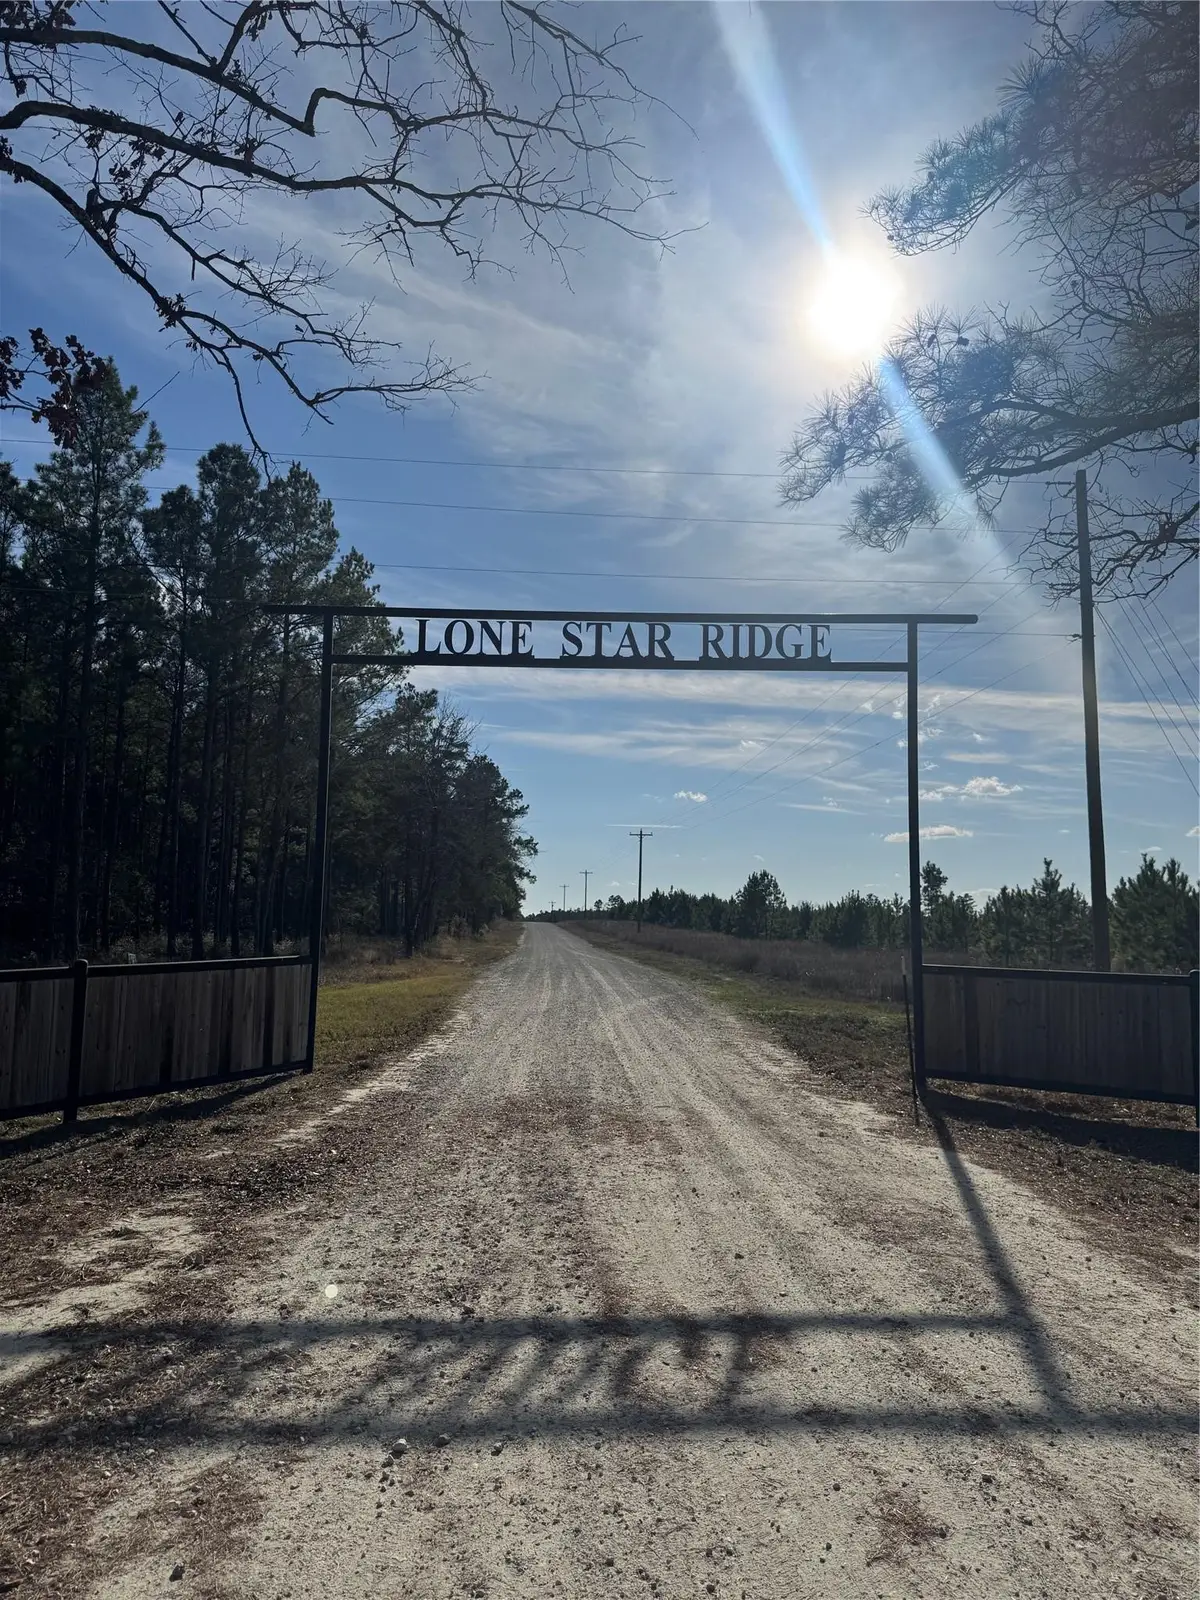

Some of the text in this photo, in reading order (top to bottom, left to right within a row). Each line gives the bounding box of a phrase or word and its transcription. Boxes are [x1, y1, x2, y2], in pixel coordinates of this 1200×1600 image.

[416, 619, 832, 660] LONE STAR RIDGE
